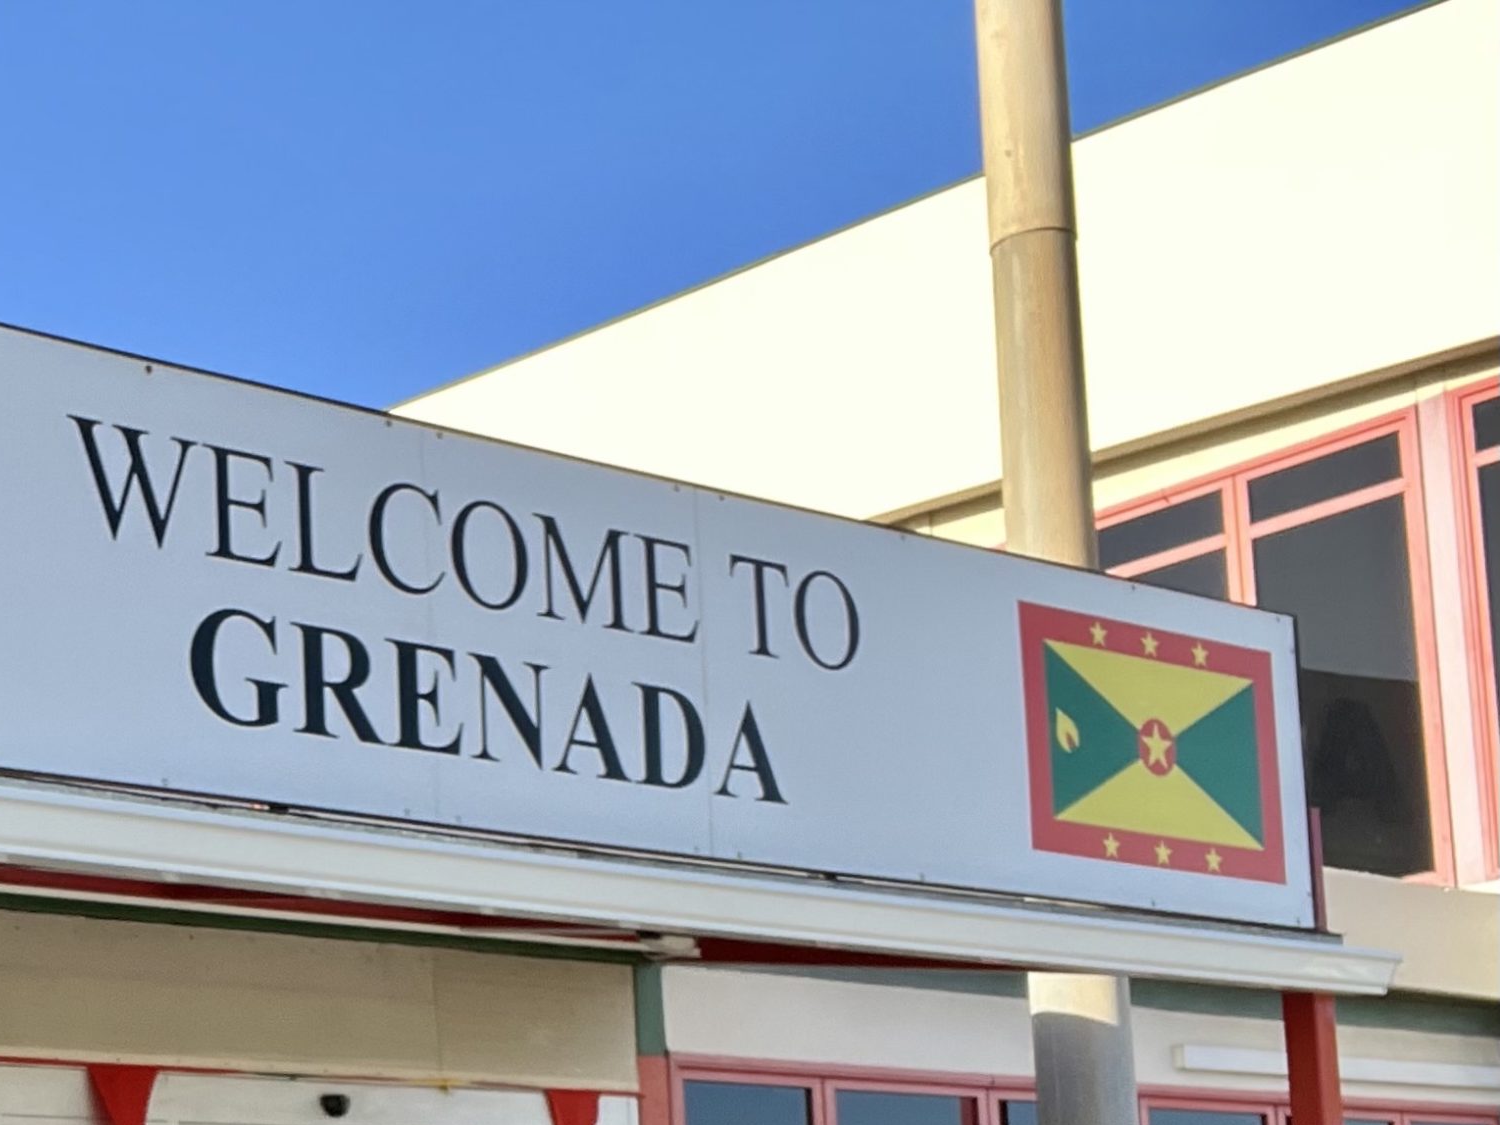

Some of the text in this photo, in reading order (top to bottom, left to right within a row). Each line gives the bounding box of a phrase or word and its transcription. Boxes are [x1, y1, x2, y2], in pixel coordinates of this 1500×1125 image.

[67, 413, 861, 672] WELCOME TO
[188, 607, 790, 805] GRENADA
